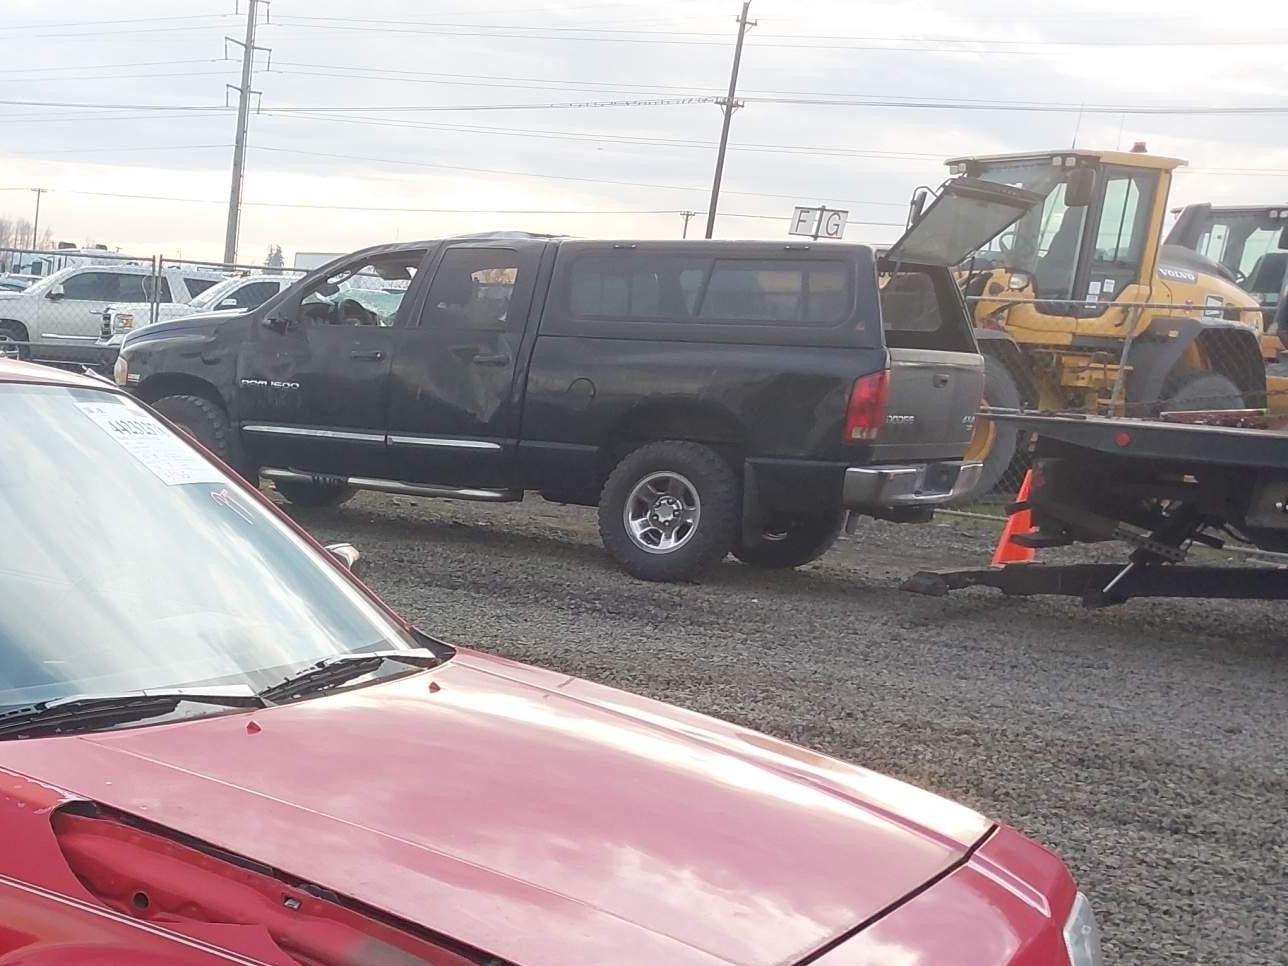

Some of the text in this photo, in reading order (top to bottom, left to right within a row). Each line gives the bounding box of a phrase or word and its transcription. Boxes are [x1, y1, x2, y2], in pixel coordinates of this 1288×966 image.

[795, 210, 810, 232] F
[825, 212, 841, 236] G
[1159, 267, 1196, 281] VOLVO
